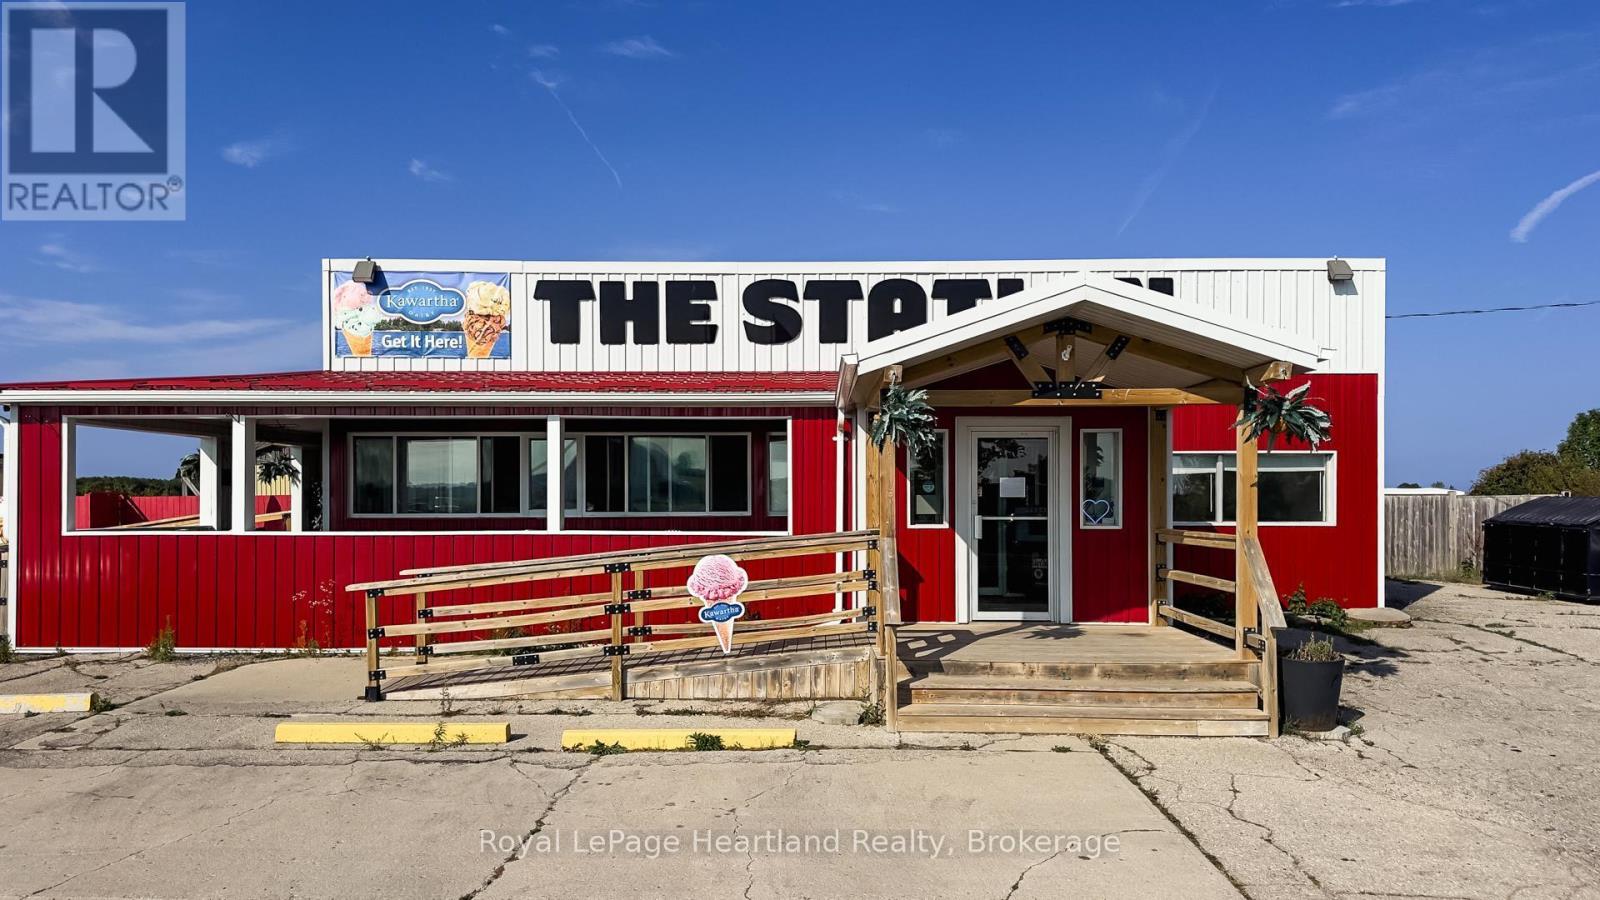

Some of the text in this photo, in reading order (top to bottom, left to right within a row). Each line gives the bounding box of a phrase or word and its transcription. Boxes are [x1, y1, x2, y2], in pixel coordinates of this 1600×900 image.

[386, 294, 458, 309] Kawartha
[533, 278, 1174, 345] THE STAT
[382, 335, 463, 349] Get It Here!
[704, 606, 740, 618] Kawartha
